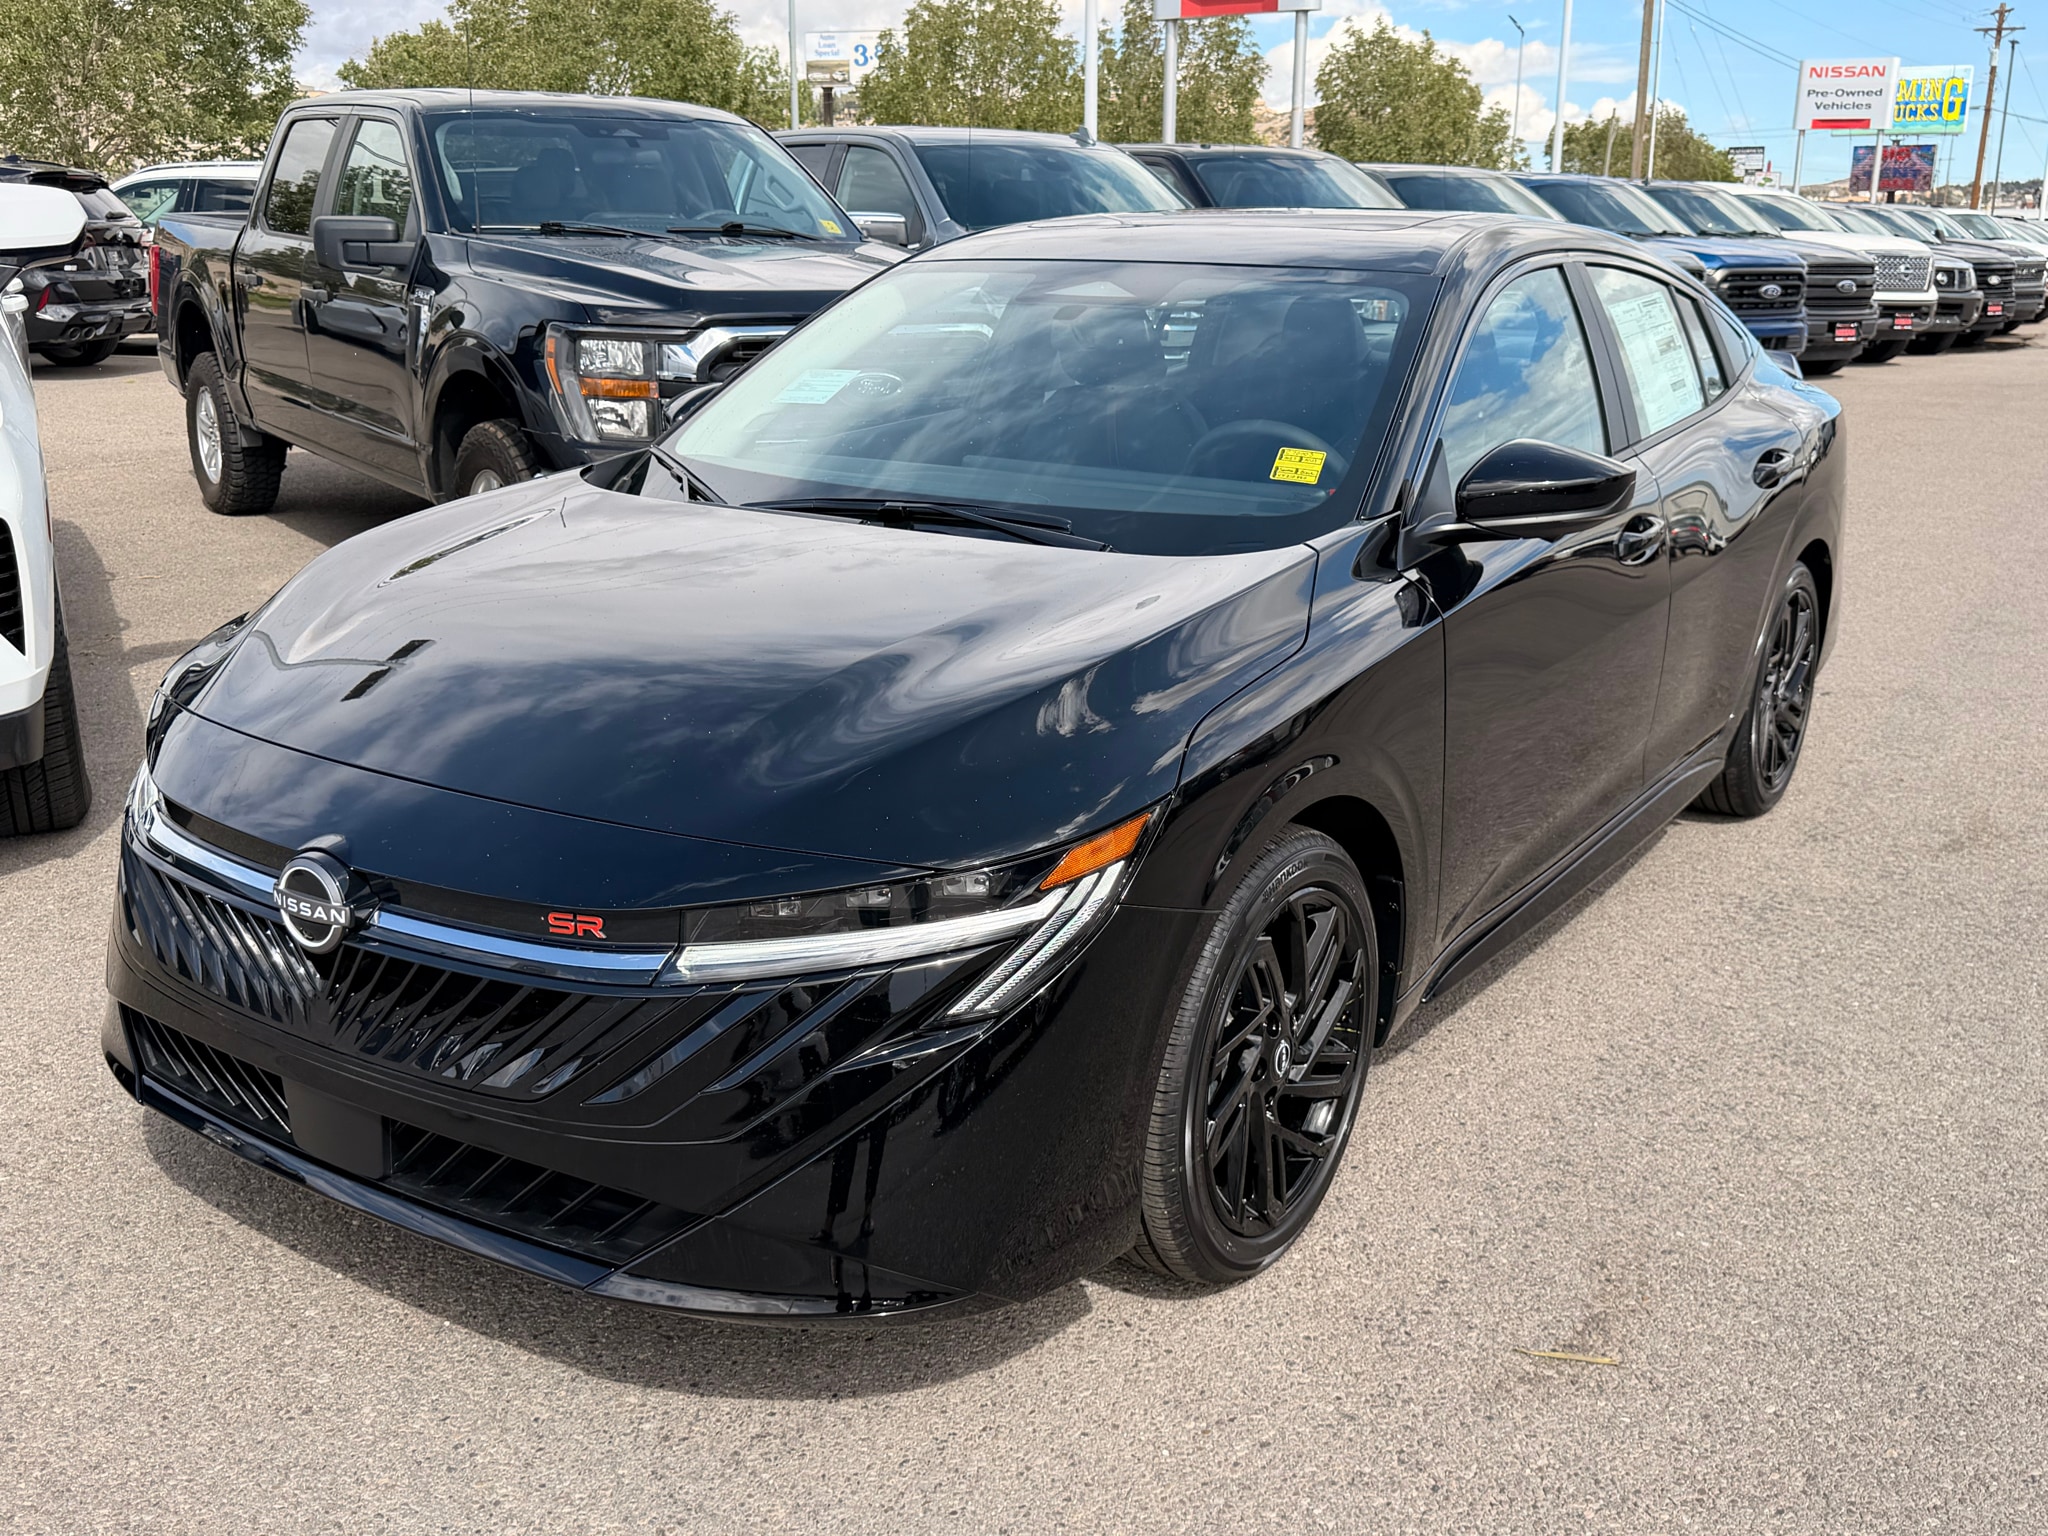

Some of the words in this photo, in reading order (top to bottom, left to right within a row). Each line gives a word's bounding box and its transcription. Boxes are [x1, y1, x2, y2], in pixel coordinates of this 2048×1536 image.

[815, 49, 840, 57] Special
[1809, 65, 1886, 79] NISSAN
[1806, 88, 1883, 99] Pre-Owned
[1814, 101, 1872, 111] Vehicles
[273, 889, 346, 924] NISSAN
[547, 911, 607, 939] SR
